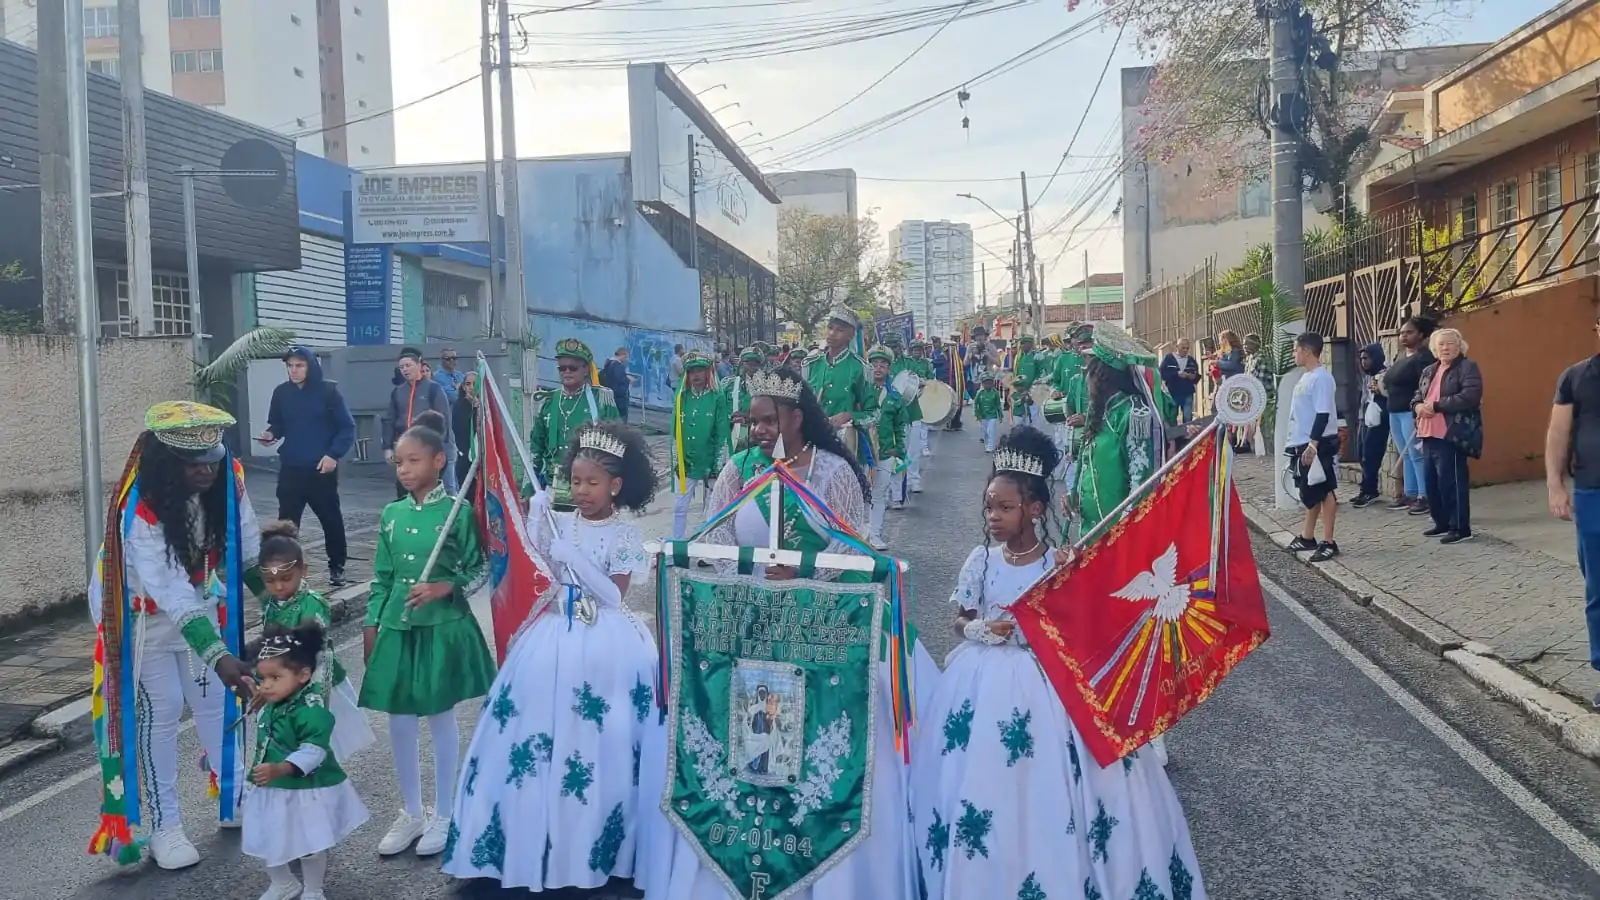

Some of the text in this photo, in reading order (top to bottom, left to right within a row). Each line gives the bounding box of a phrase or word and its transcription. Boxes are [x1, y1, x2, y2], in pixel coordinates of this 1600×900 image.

[358, 175, 479, 195] JOE IMPRESS
[352, 323, 381, 338] 1145
[694, 600, 848, 628] SANTA EFIGENIA
[752, 623, 805, 642] SANTA
[807, 624, 870, 645] TEREZA
[694, 633, 848, 662] MOGI DAS CRUZES
[750, 872, 770, 900] F
